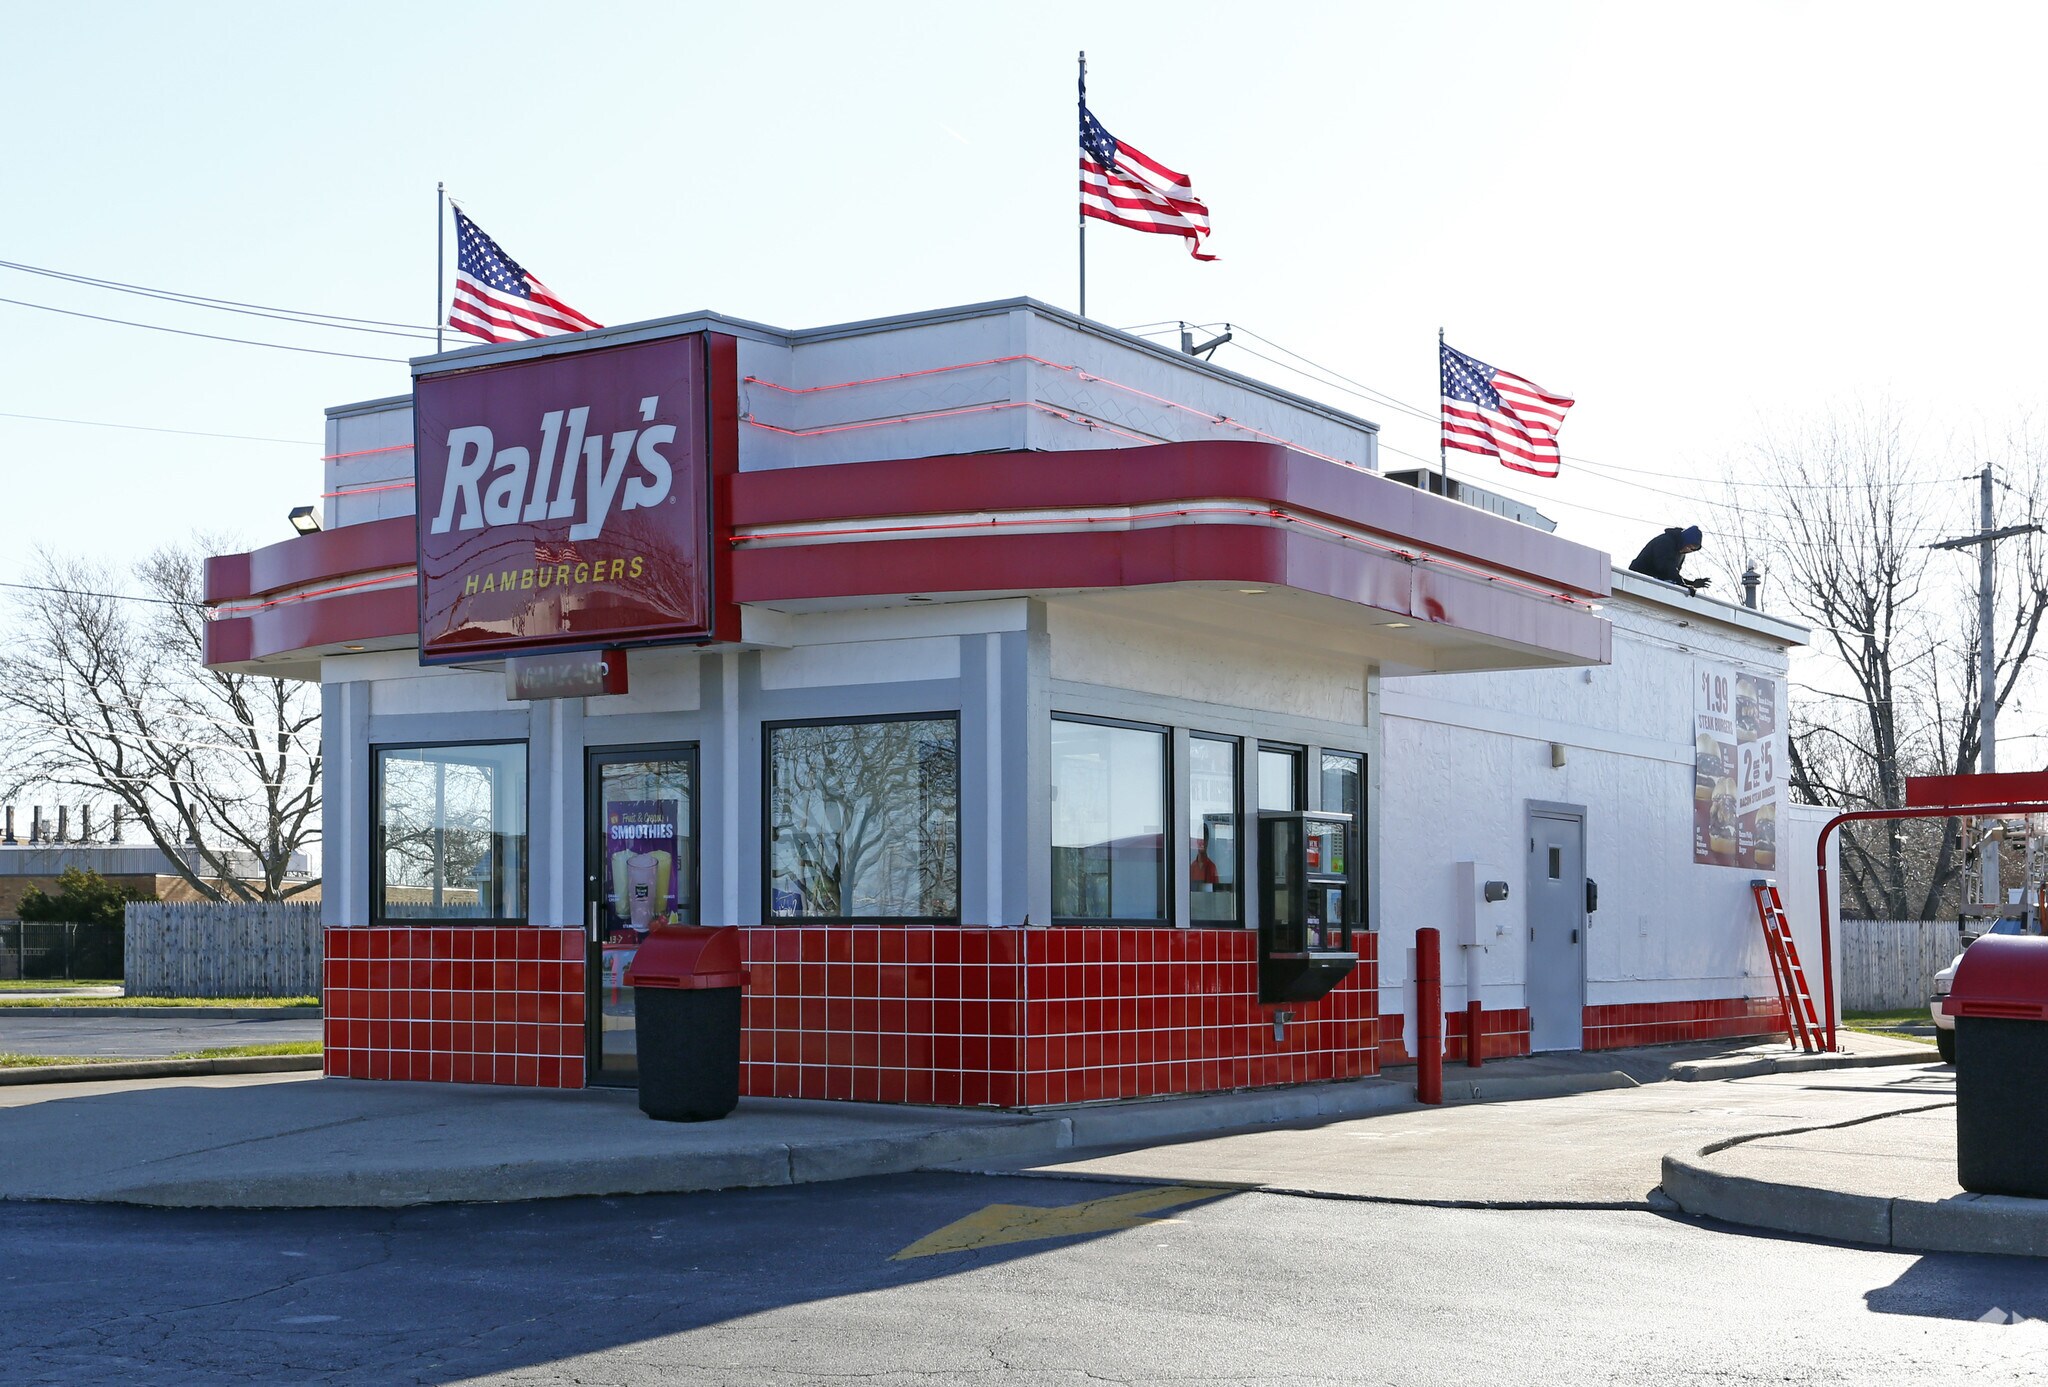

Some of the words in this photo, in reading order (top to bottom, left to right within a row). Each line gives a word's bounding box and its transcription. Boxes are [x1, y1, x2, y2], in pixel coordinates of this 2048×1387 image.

[430, 395, 677, 542] Rally's
[464, 556, 644, 596] HAMBURGERS
[1701, 670, 1729, 715] $1.99
[1743, 748, 1753, 793] 2
[1760, 740, 1773, 783] $5
[611, 823, 674, 840] SMOOTHIES
